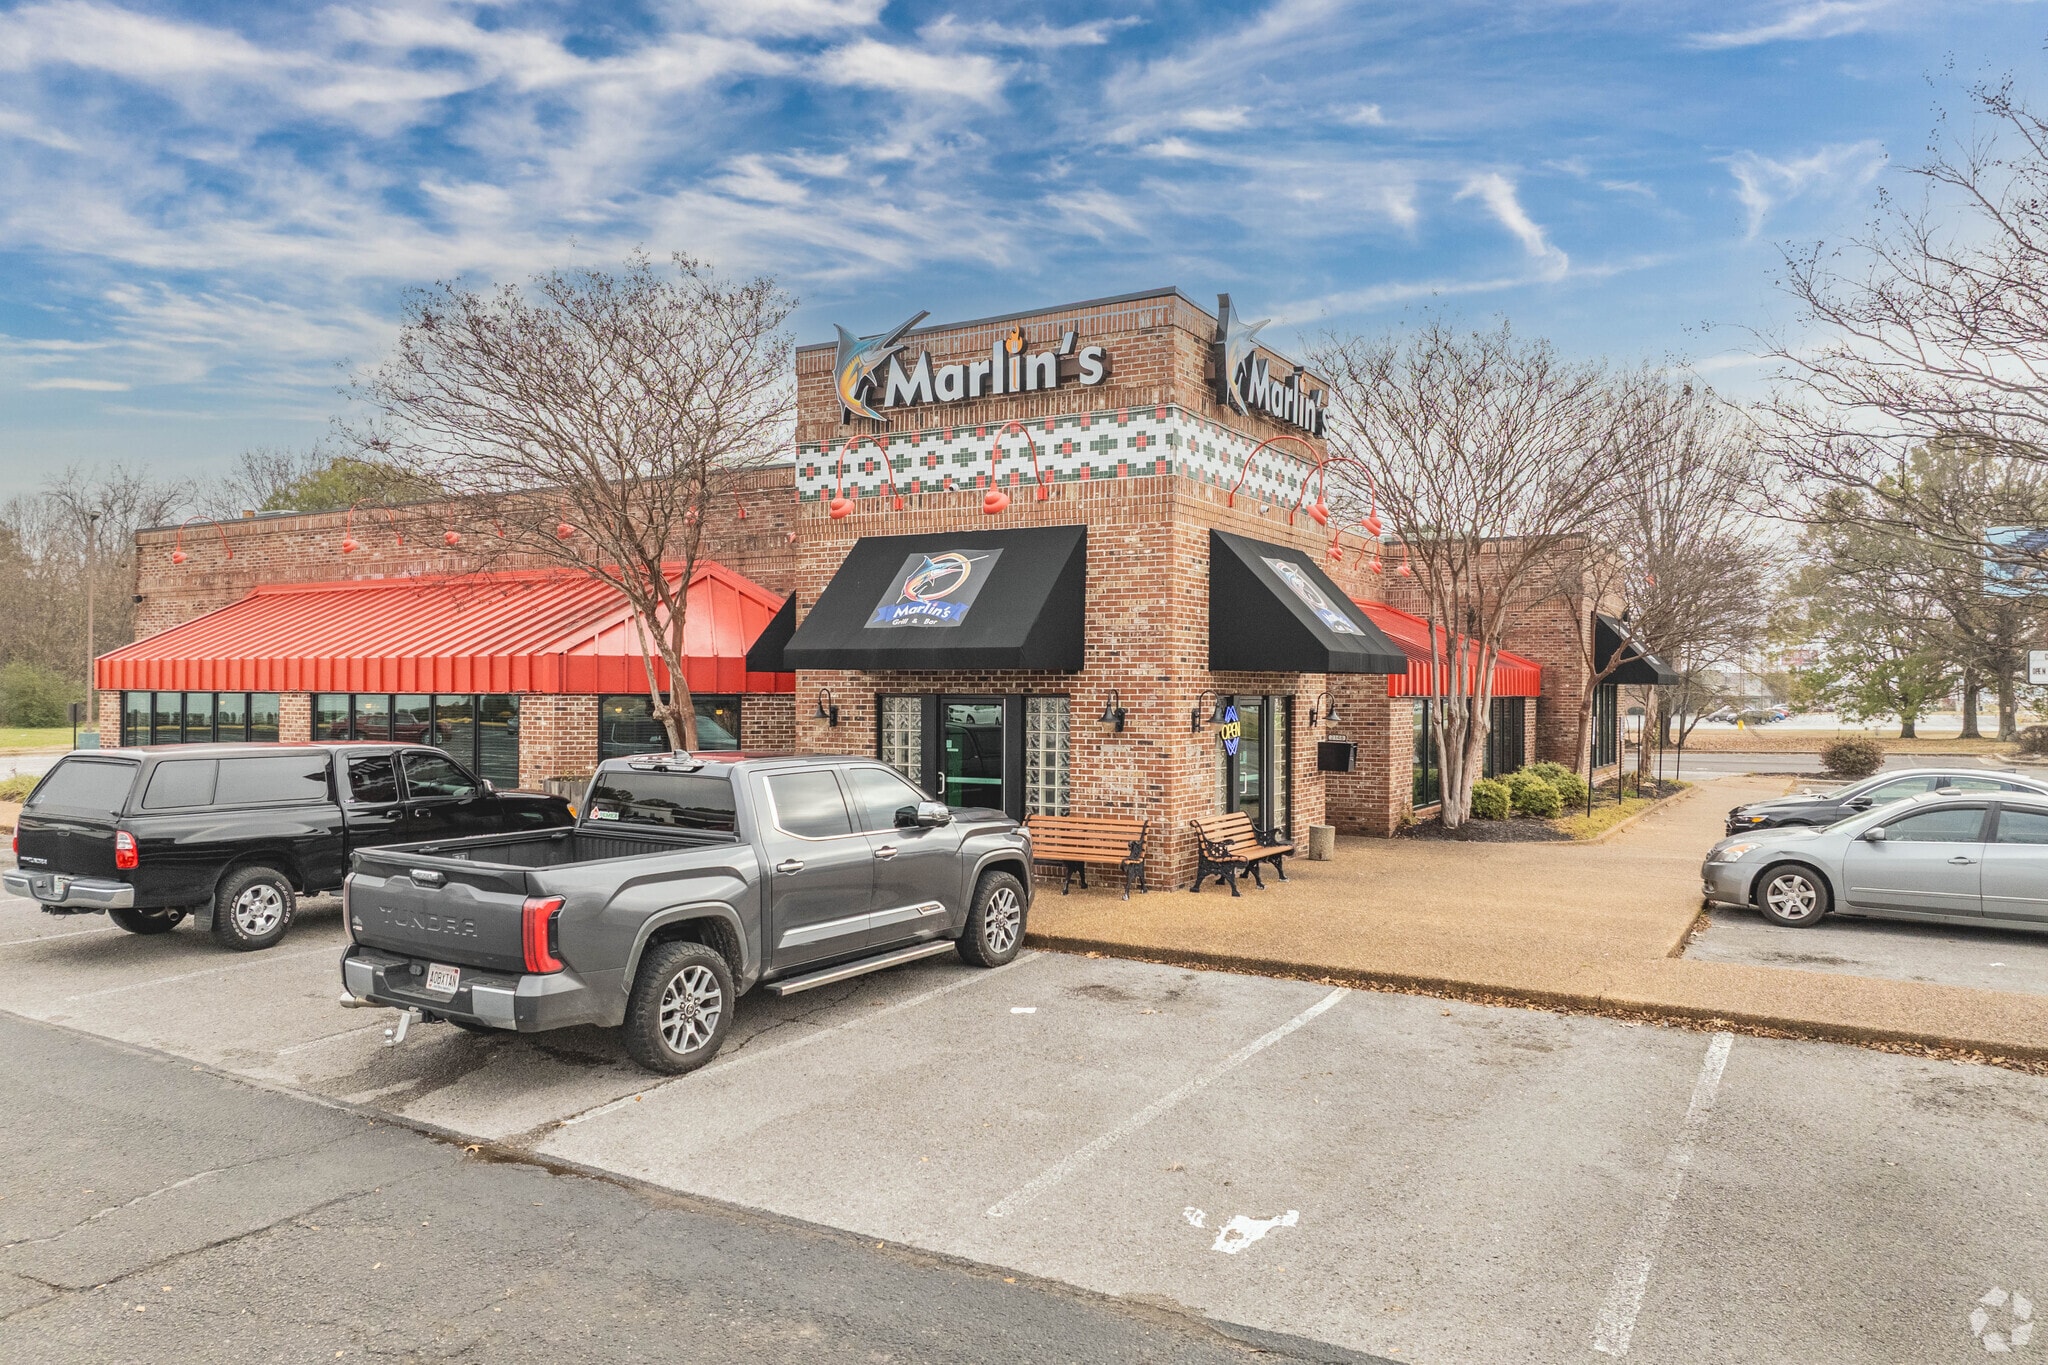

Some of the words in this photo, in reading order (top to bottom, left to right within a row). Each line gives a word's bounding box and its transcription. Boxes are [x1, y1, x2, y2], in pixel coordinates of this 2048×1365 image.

[884, 327, 1105, 407] Marlin's
[1248, 352, 1330, 440] Marlin's
[893, 602, 951, 618] Marlin's
[1221, 721, 1241, 740] OPEN
[379, 906, 478, 937] TUNDRA
